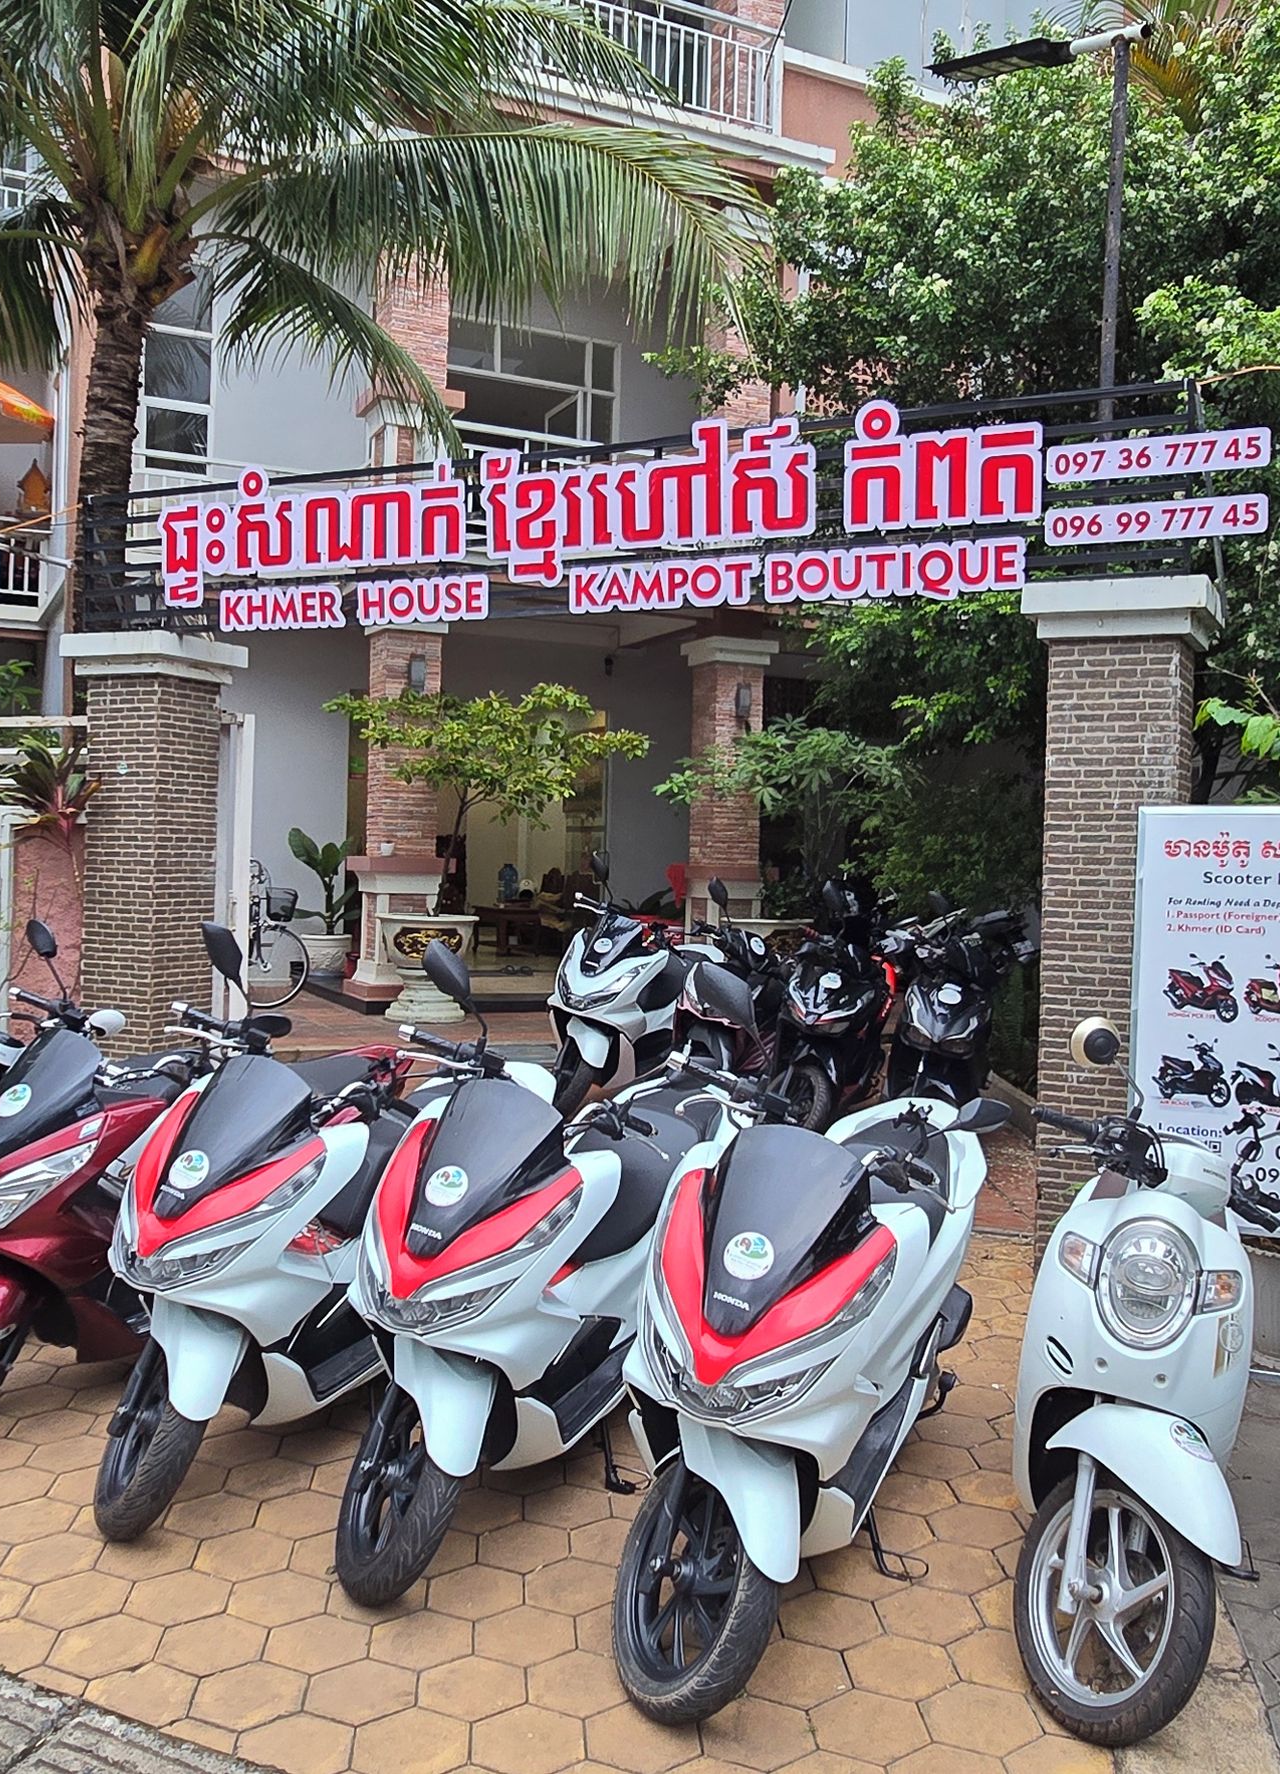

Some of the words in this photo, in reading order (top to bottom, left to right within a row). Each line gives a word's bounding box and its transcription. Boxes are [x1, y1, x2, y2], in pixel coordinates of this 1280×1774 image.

[1055, 450, 1104, 475] 097
[1118, 445, 1152, 469] 36
[1164, 439, 1218, 467] 777
[1224, 436, 1261, 461] 45
[851, 407, 1035, 525] កំពត
[1052, 512, 1102, 538] 096
[1116, 510, 1150, 534] 99
[1162, 505, 1213, 532] 777
[1223, 502, 1259, 526] 45
[224, 590, 340, 626] KHMER
[362, 580, 483, 620] HOUSE
[575, 562, 753, 607] KAMPOT
[771, 544, 1018, 597] BOUTIQUE
[1203, 871, 1271, 885] Scooter
[1167, 897, 1183, 905] For
[1185, 898, 1221, 908] Renting
[1224, 898, 1250, 907] Need
[1176, 910, 1221, 920] Passport
[1177, 923, 1213, 933] Khmer
[1215, 925, 1232, 935] (ID
[1235, 925, 1266, 936] Card)
[411, 1222, 443, 1240] HONDA
[713, 1291, 750, 1311] HONDA
